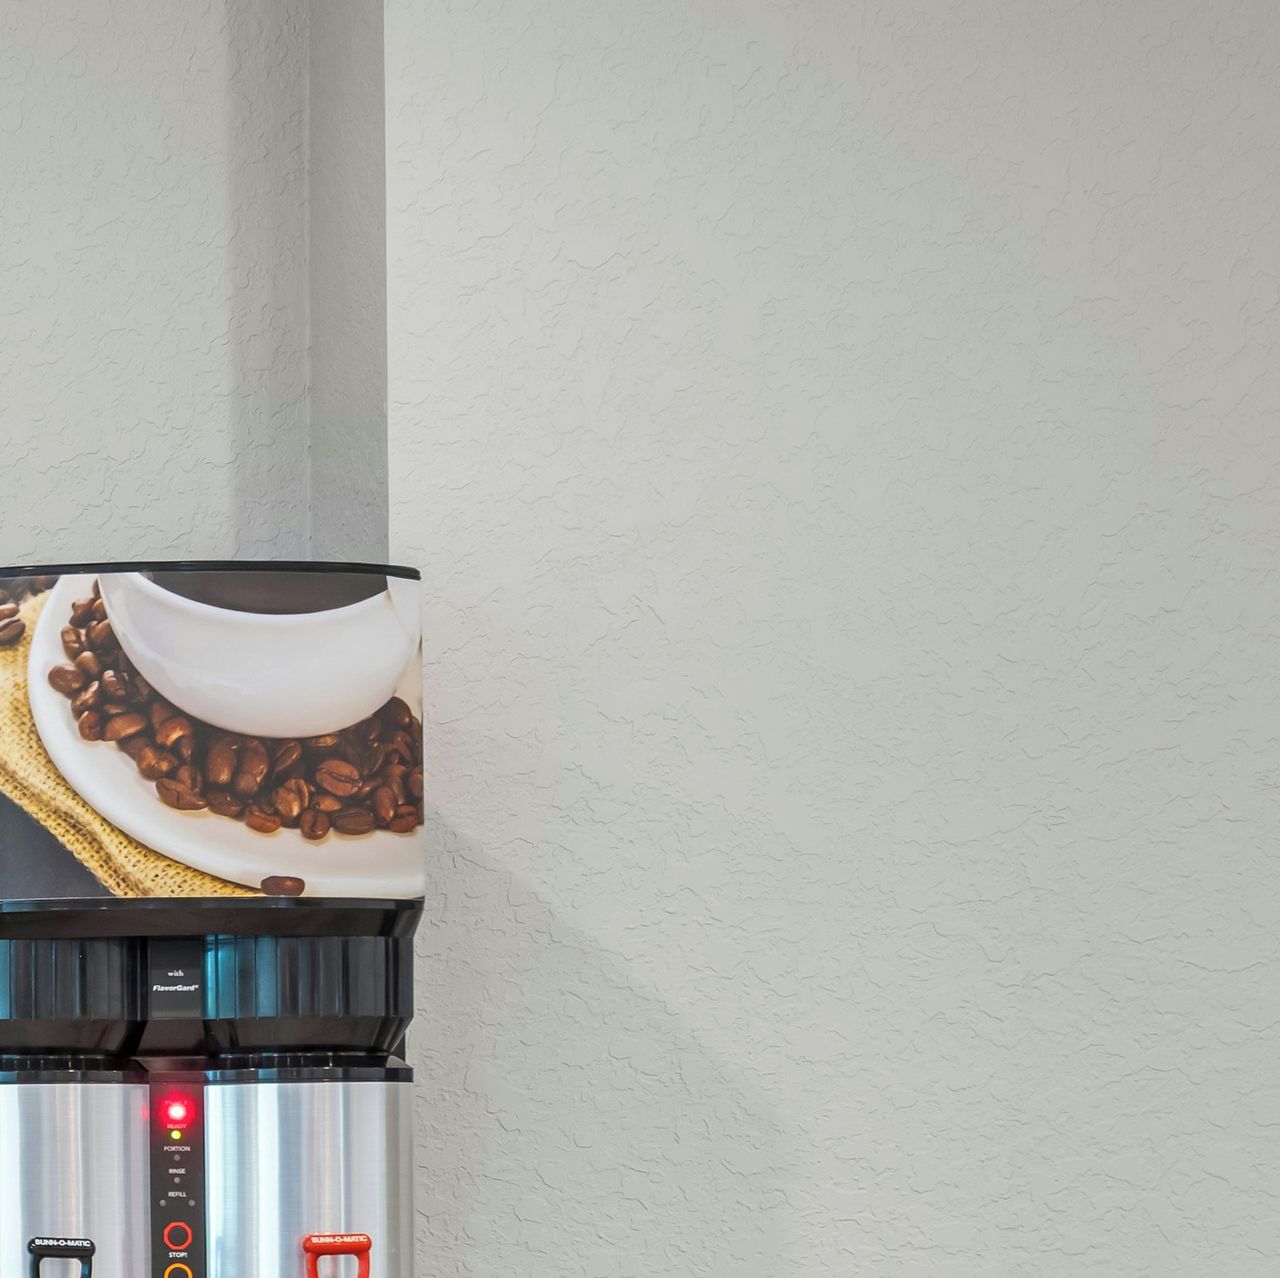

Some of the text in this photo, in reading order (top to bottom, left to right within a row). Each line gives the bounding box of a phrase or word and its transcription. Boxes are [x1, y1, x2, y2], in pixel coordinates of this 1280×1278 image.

[167, 969, 185, 977] with
[34, 1238, 92, 1247] BUNN-O-MATIC
[311, 1235, 368, 1244] BUNN-O-MATIC
